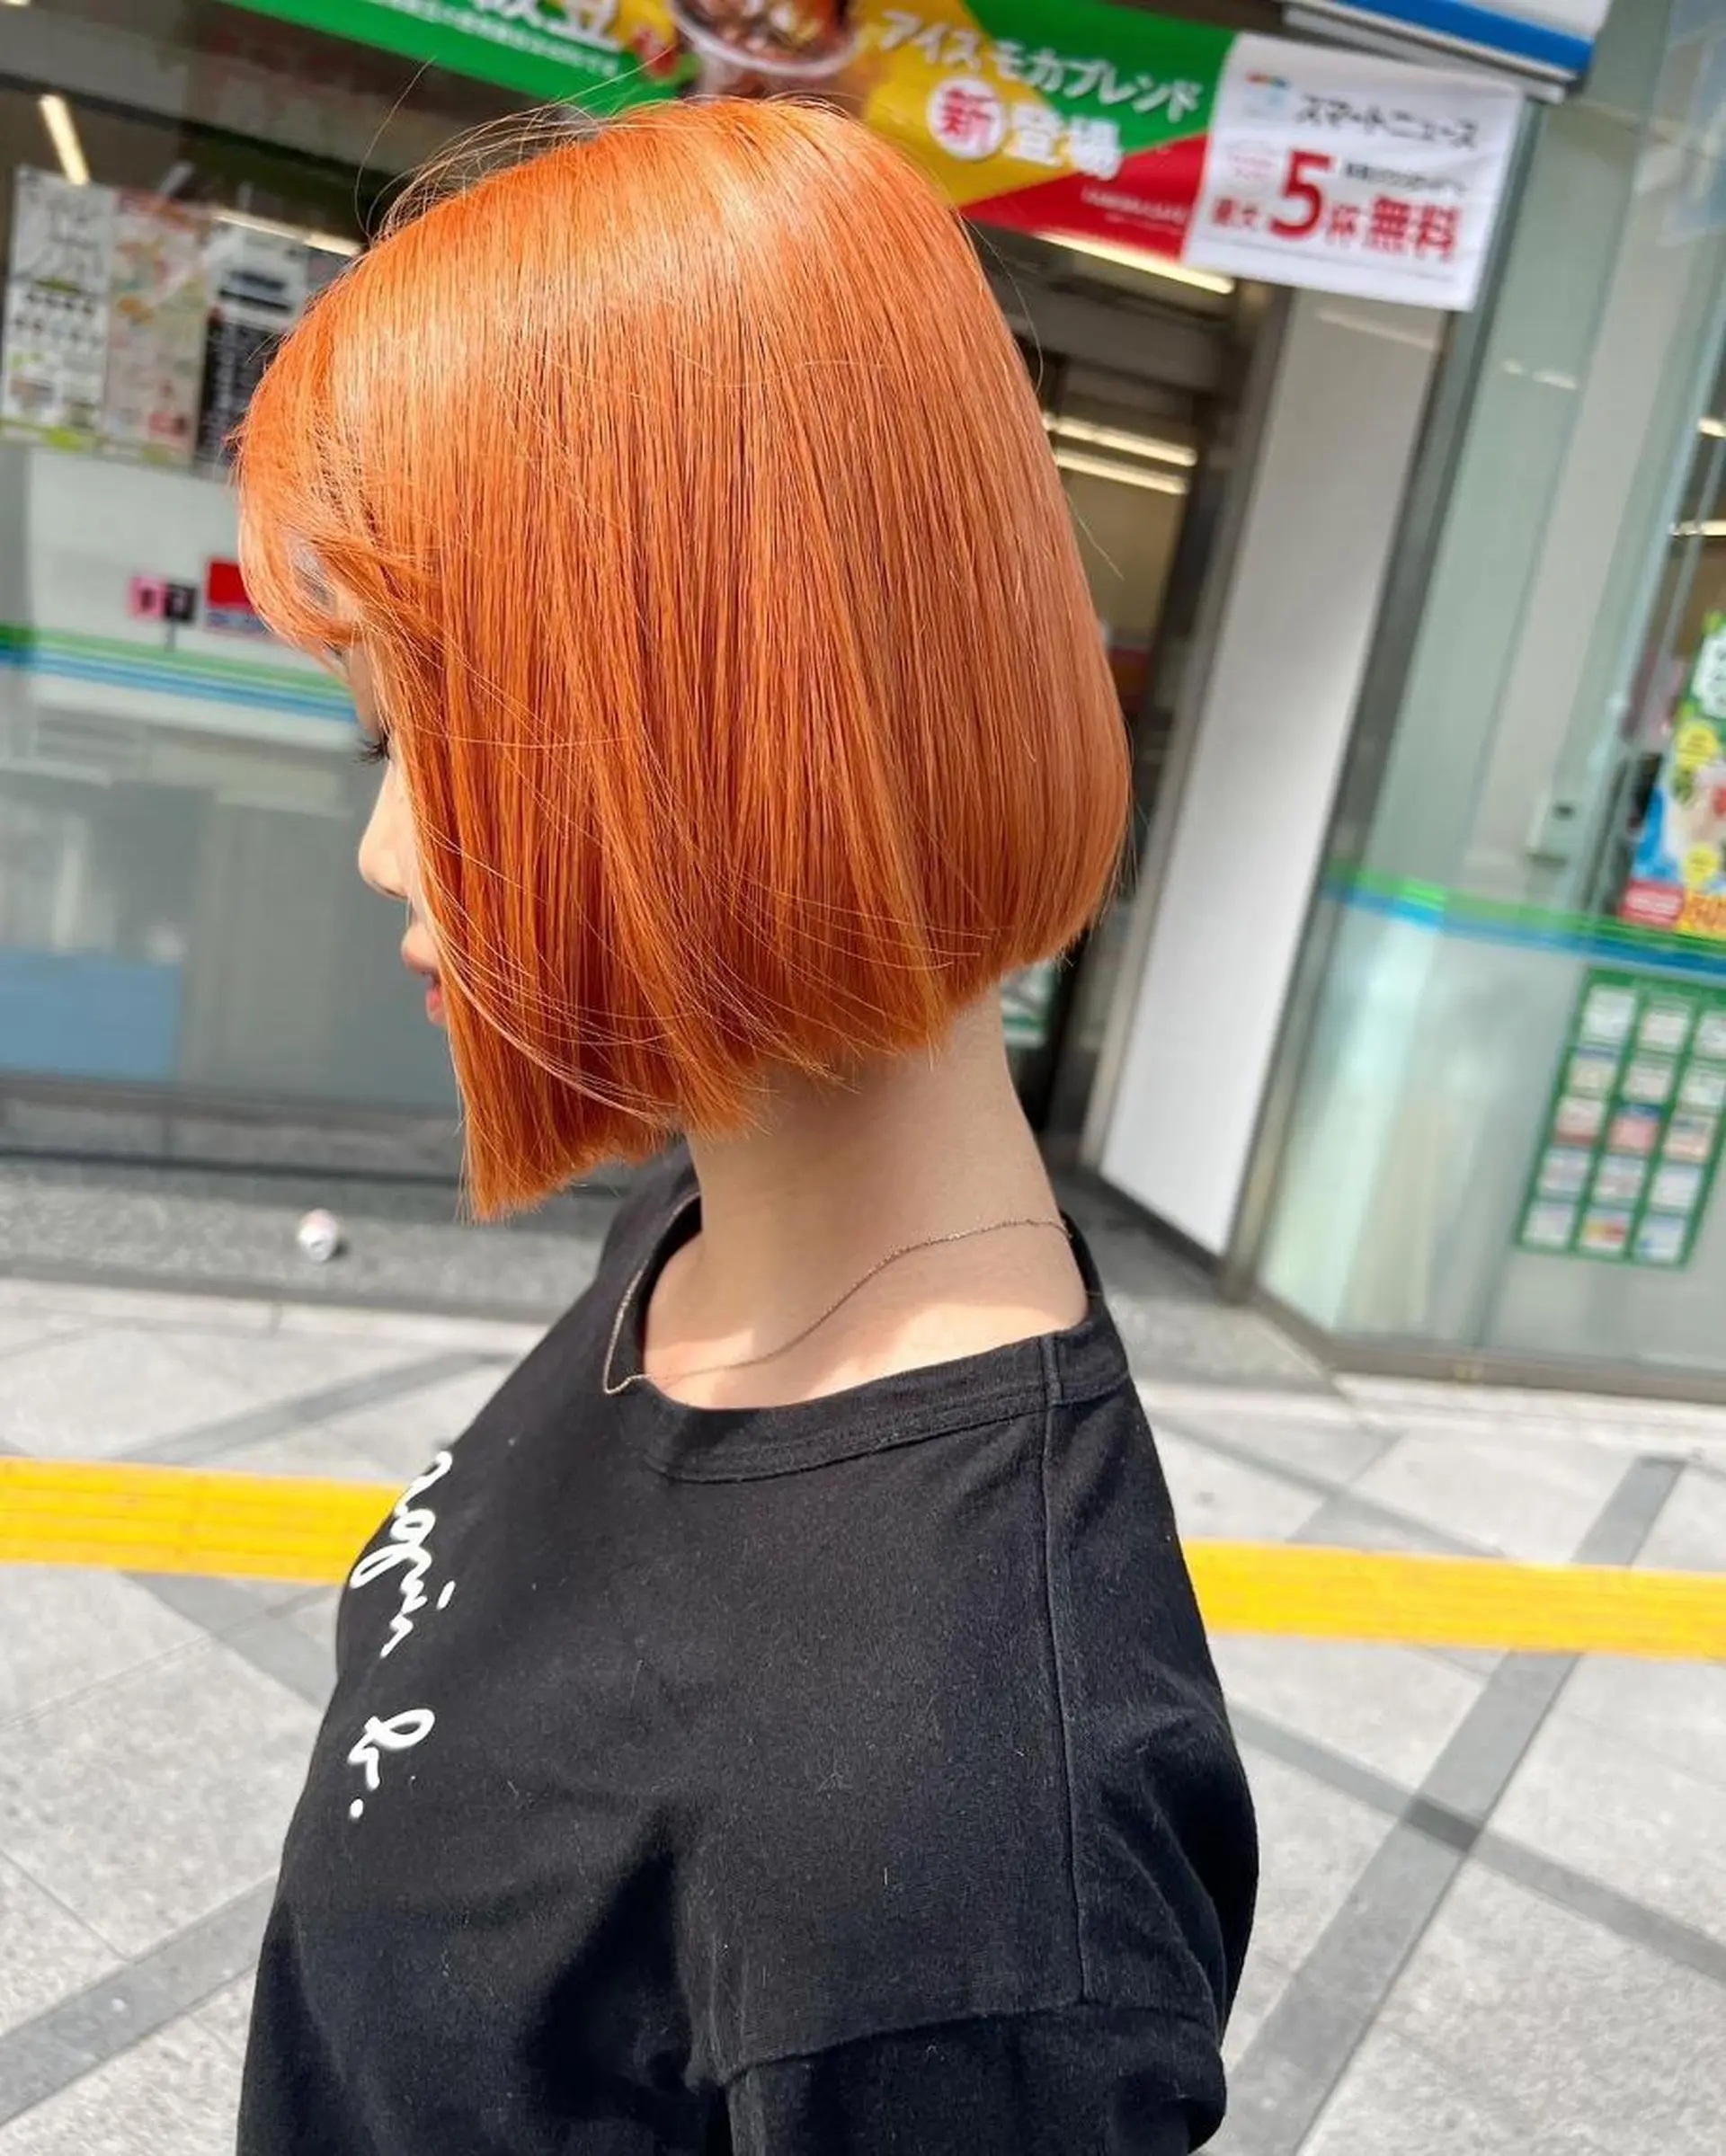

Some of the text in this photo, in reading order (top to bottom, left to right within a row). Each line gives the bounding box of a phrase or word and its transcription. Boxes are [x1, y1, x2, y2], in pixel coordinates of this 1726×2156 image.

[1294, 93, 1480, 149] スマートニュース
